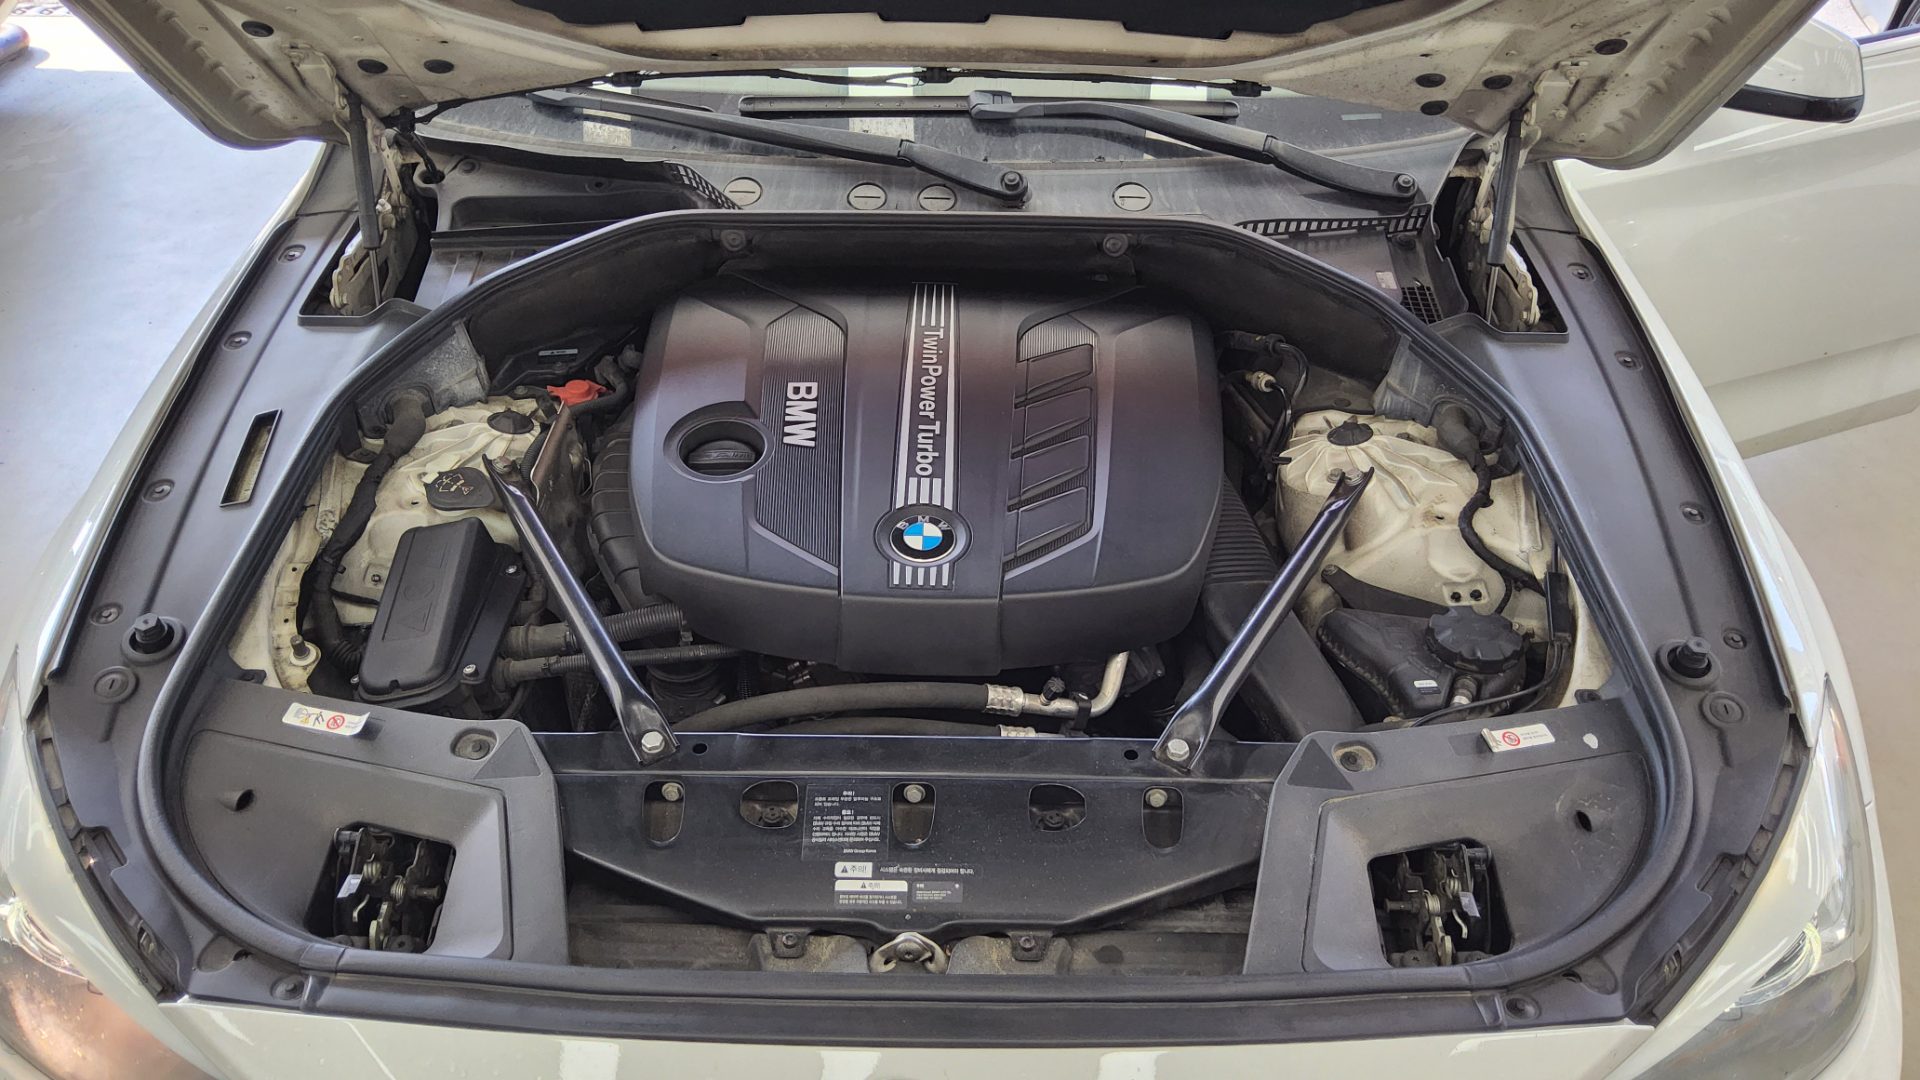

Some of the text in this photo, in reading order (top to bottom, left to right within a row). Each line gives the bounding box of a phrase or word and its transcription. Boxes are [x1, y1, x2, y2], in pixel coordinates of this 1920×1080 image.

[783, 381, 818, 448] BMW
[915, 328, 944, 476] TwinPower Turbo
[896, 515, 951, 530] BMW
